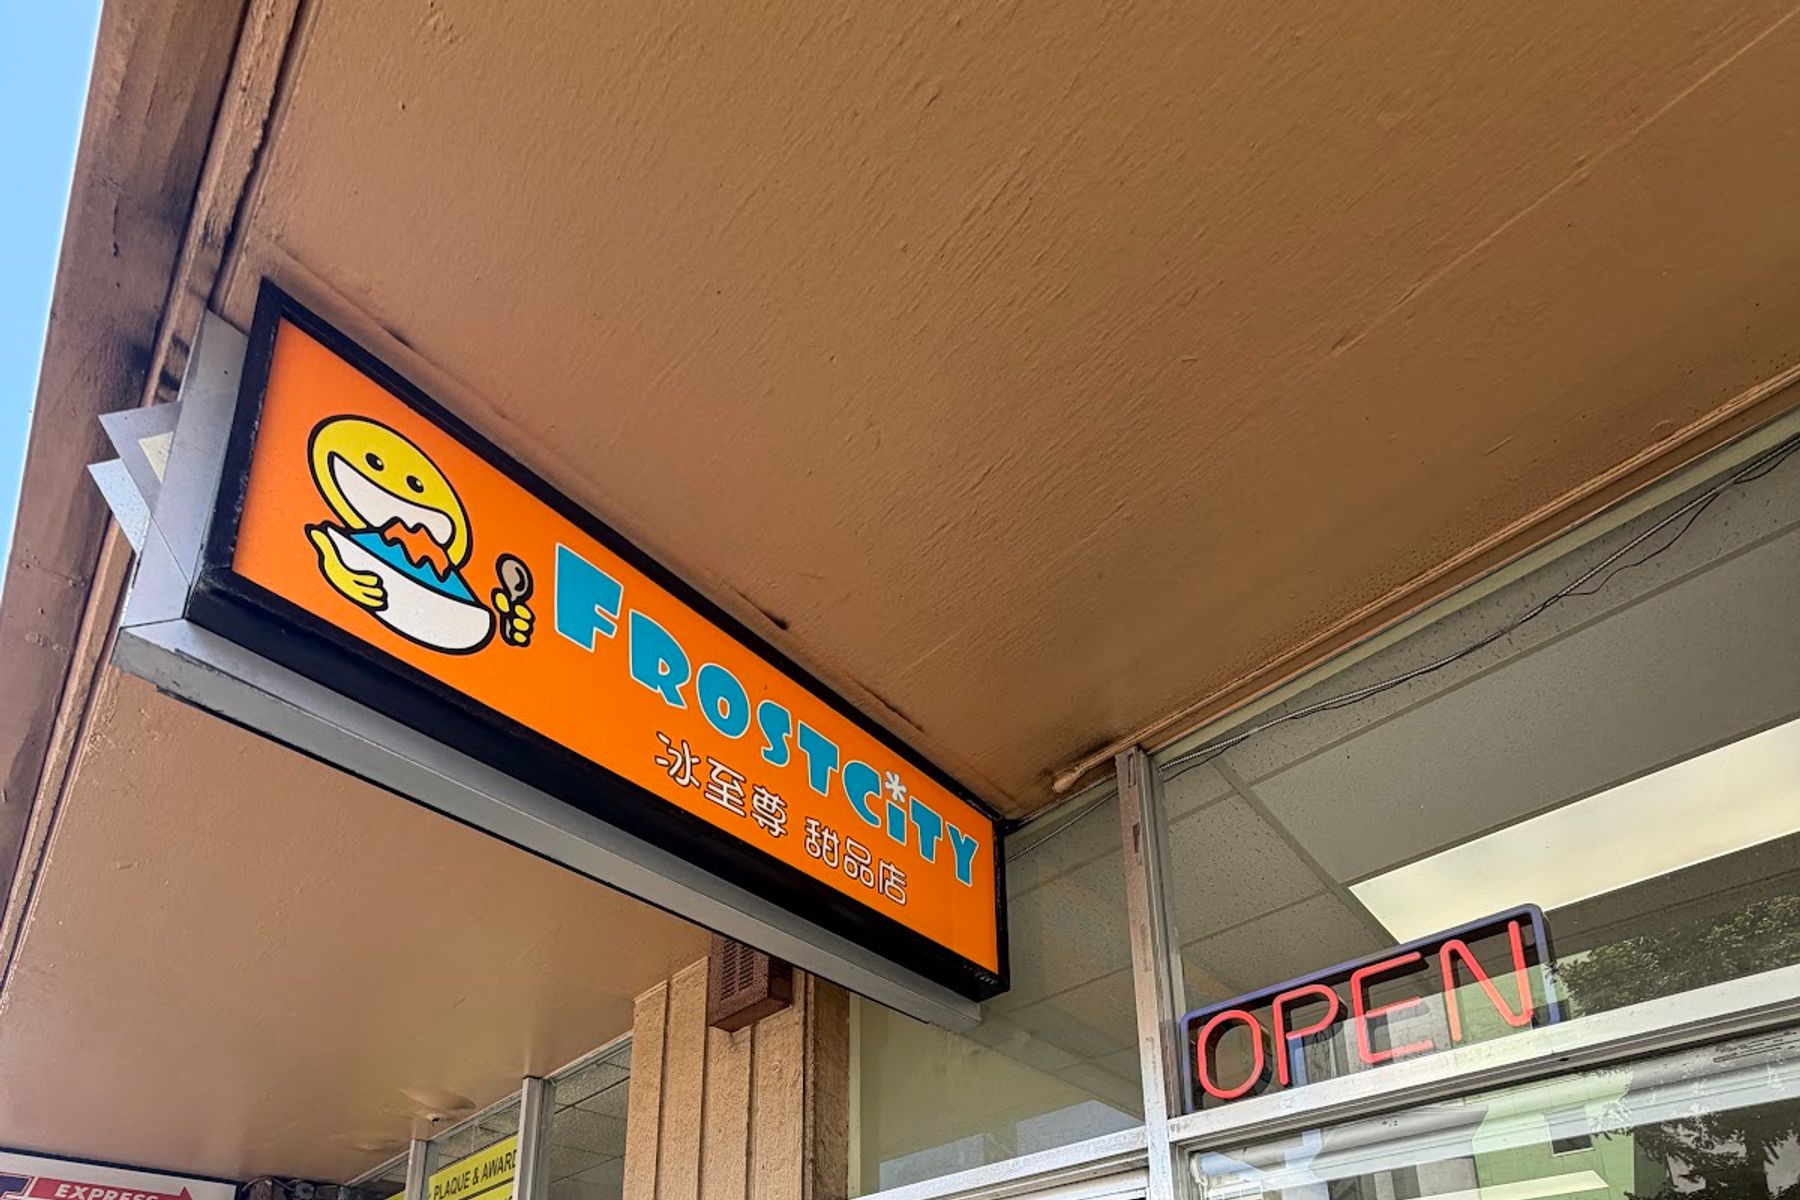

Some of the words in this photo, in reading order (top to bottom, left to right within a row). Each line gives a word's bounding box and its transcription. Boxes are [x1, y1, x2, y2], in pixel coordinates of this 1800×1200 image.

[654, 731, 788, 838] 冰至尊
[804, 816, 907, 906] 甜品店
[1196, 919, 1534, 1100] OPEN
[472, 1166, 480, 1186] &
